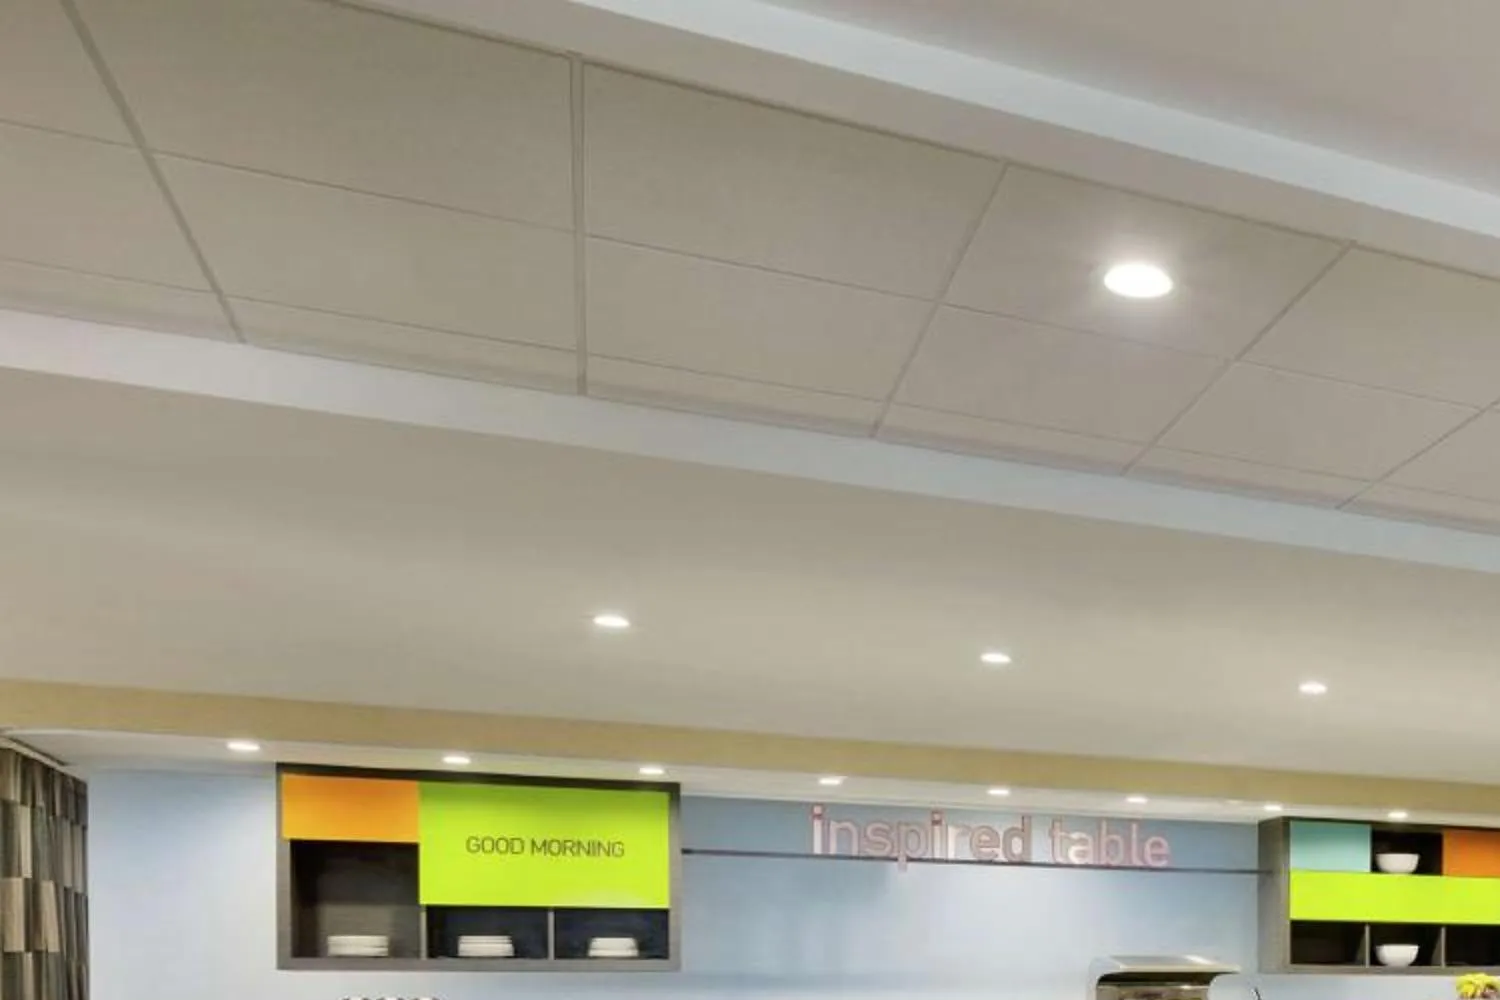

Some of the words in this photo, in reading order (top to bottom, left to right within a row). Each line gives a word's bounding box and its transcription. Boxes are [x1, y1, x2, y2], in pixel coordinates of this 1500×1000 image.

[465, 835, 525, 855] GOOD
[531, 837, 625, 858] MORNING
[809, 802, 1032, 872] inspired
[1050, 817, 1172, 867] table
